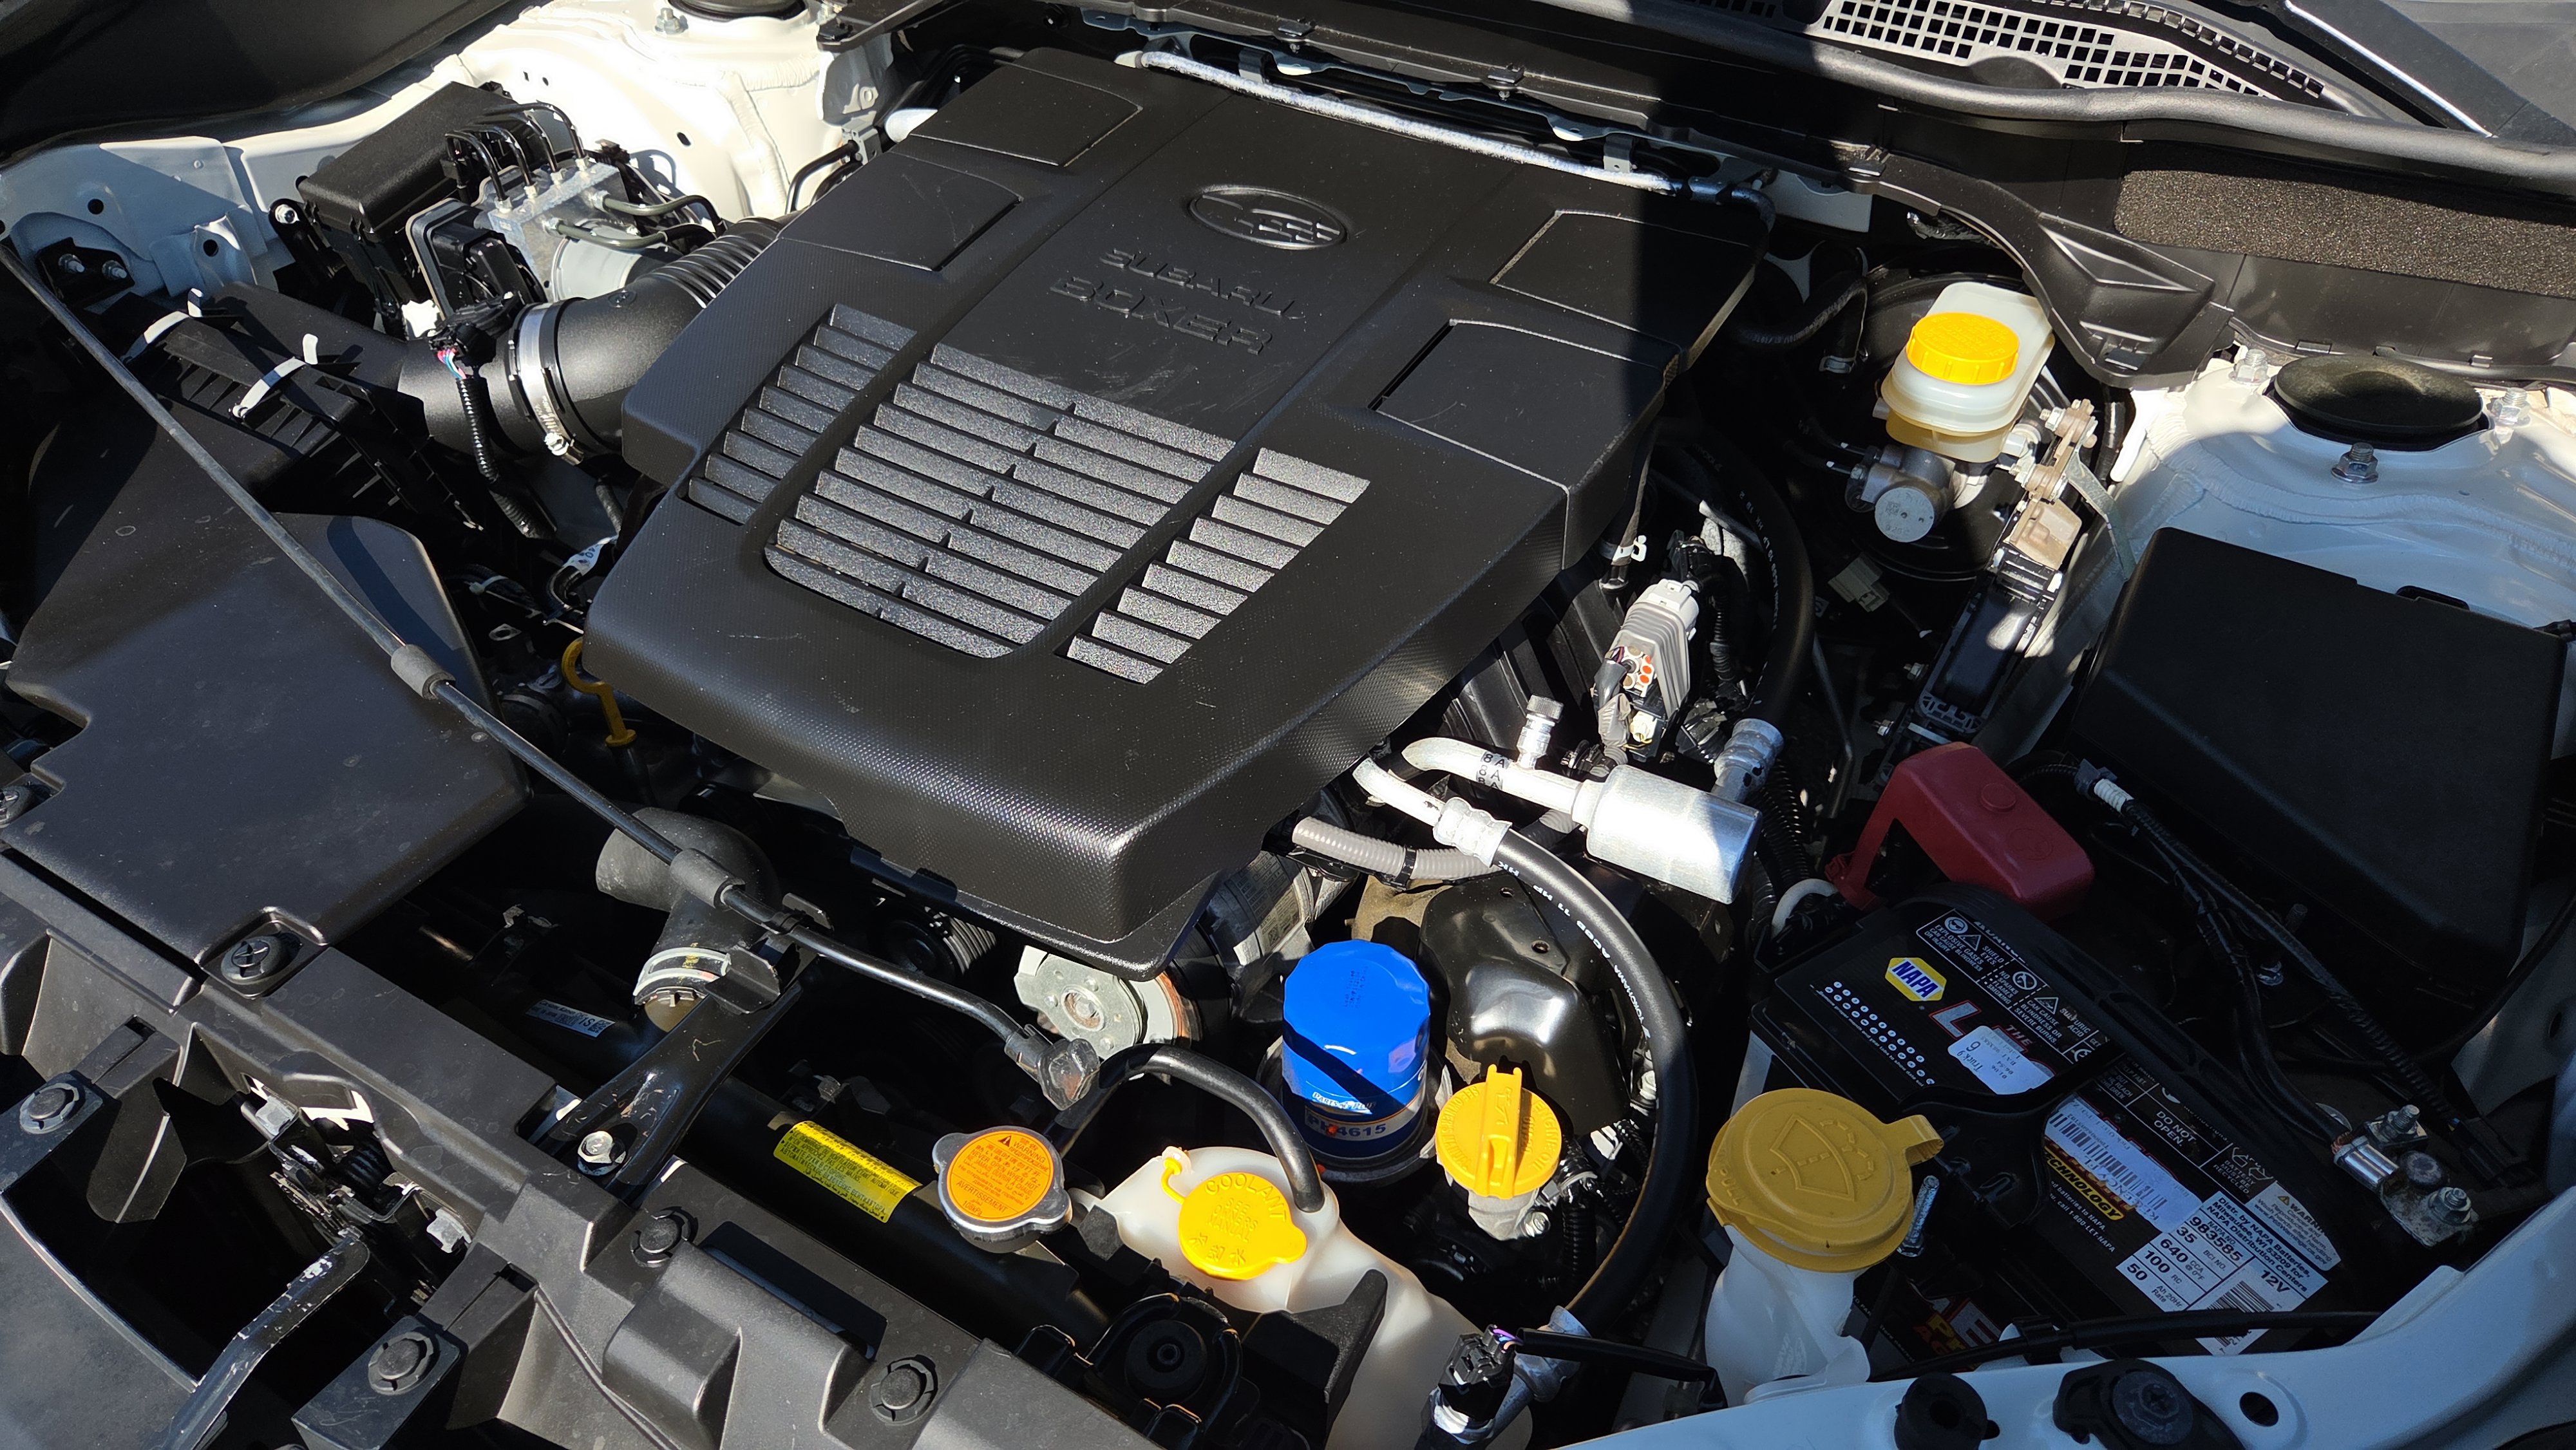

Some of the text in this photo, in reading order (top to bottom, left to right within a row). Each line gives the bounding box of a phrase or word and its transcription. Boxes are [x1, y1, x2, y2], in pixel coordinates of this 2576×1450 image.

[1101, 249, 1303, 319] SUBARU
[1050, 276, 1271, 355] BOXER
[1478, 764, 1501, 782] 8 A
[1482, 753, 1506, 768] 8 A
[1498, 860, 1520, 880] HK
[1929, 927, 1983, 972] CAN CAUSE BLINDNESS
[1935, 923, 1965, 949] EXPLOSIVE
[1964, 948, 1984, 965] GASES
[1982, 945, 2004, 963] SHIELD
[1892, 961, 1938, 997] NAPA
[1996, 977, 2018, 995] SPARKS
[1998, 970, 2011, 979] NO
[1986, 983, 2011, 1004] SMOKING
[1992, 980, 2014, 998] FLAMES
[2014, 1007, 2058, 1044] SEVERE BURNS.
[2020, 1003, 2062, 1038] BLINDNESS OR
[2026, 999, 2059, 1026] CAN CAUSE
[2059, 1007, 2090, 1033] SULFURIC
[2005, 1024, 2033, 1046] THE
[2067, 1024, 2085, 1037] ACID
[1962, 1053, 1983, 1071] Truck
[1313, 1092, 1338, 1106] PARTS
[1464, 1086, 1479, 1101] SEE
[2153, 1119, 2184, 1147] OPEN.
[2155, 1111, 2196, 1142] DO NOT
[824, 1157, 836, 1166] PAS
[835, 1163, 846, 1172] LES
[1012, 1141, 1046, 1163] WARNING
[1528, 1151, 1553, 1171] OIL
[971, 1149, 990, 1163] NEVER
[990, 1160, 1007, 1172] OPEN
[1006, 1170, 1025, 1183] WHEN
[2212, 1164, 2249, 1194] RECYCLED
[2220, 1163, 2251, 1188] MUST BE
[2224, 1160, 2256, 1185] BATTERY
[955, 1180, 1008, 1212] AVERTISSEMENT
[1203, 1175, 1287, 1222] COOLANT
[1719, 1166, 1745, 1207] PULL
[1225, 1196, 1249, 1212] SEE
[2056, 1186, 2083, 1210] batteries
[2087, 1214, 2107, 1231] NAPA.
[2257, 1199, 2275, 1214] Wash
[2273, 1212, 2293, 1229] hands
[1207, 1215, 1251, 1243] MANUAL
[1211, 1205, 1258, 1231] OWNERS
[2056, 1200, 2116, 1252] call 1-800-LET-NAPA
[2270, 1203, 2310, 1236] Reproductive
[2286, 1209, 2322, 1238] Cancer and
[2188, 1216, 2243, 1261] 983585
[2206, 1220, 2237, 1247] NAPA NO.
[2211, 1201, 2305, 1279] Milwaukee, WI 53209 for
[2217, 1197, 2311, 1277] Distr. by NAPA Batteries,
[2159, 1238, 2188, 1263] 640
[2175, 1226, 2227, 1271] 35 BCI NO.
[2206, 1205, 2307, 1292] NAPA Distribution Centers
[2126, 1263, 2148, 1281] 50
[2144, 1250, 2183, 1284] 100 RC
[2189, 1259, 2204, 1273] CCA
[2155, 1285, 2167, 1294] Ah
[2260, 1269, 2289, 1294] 12V
[2151, 1288, 2167, 1303] Rate
